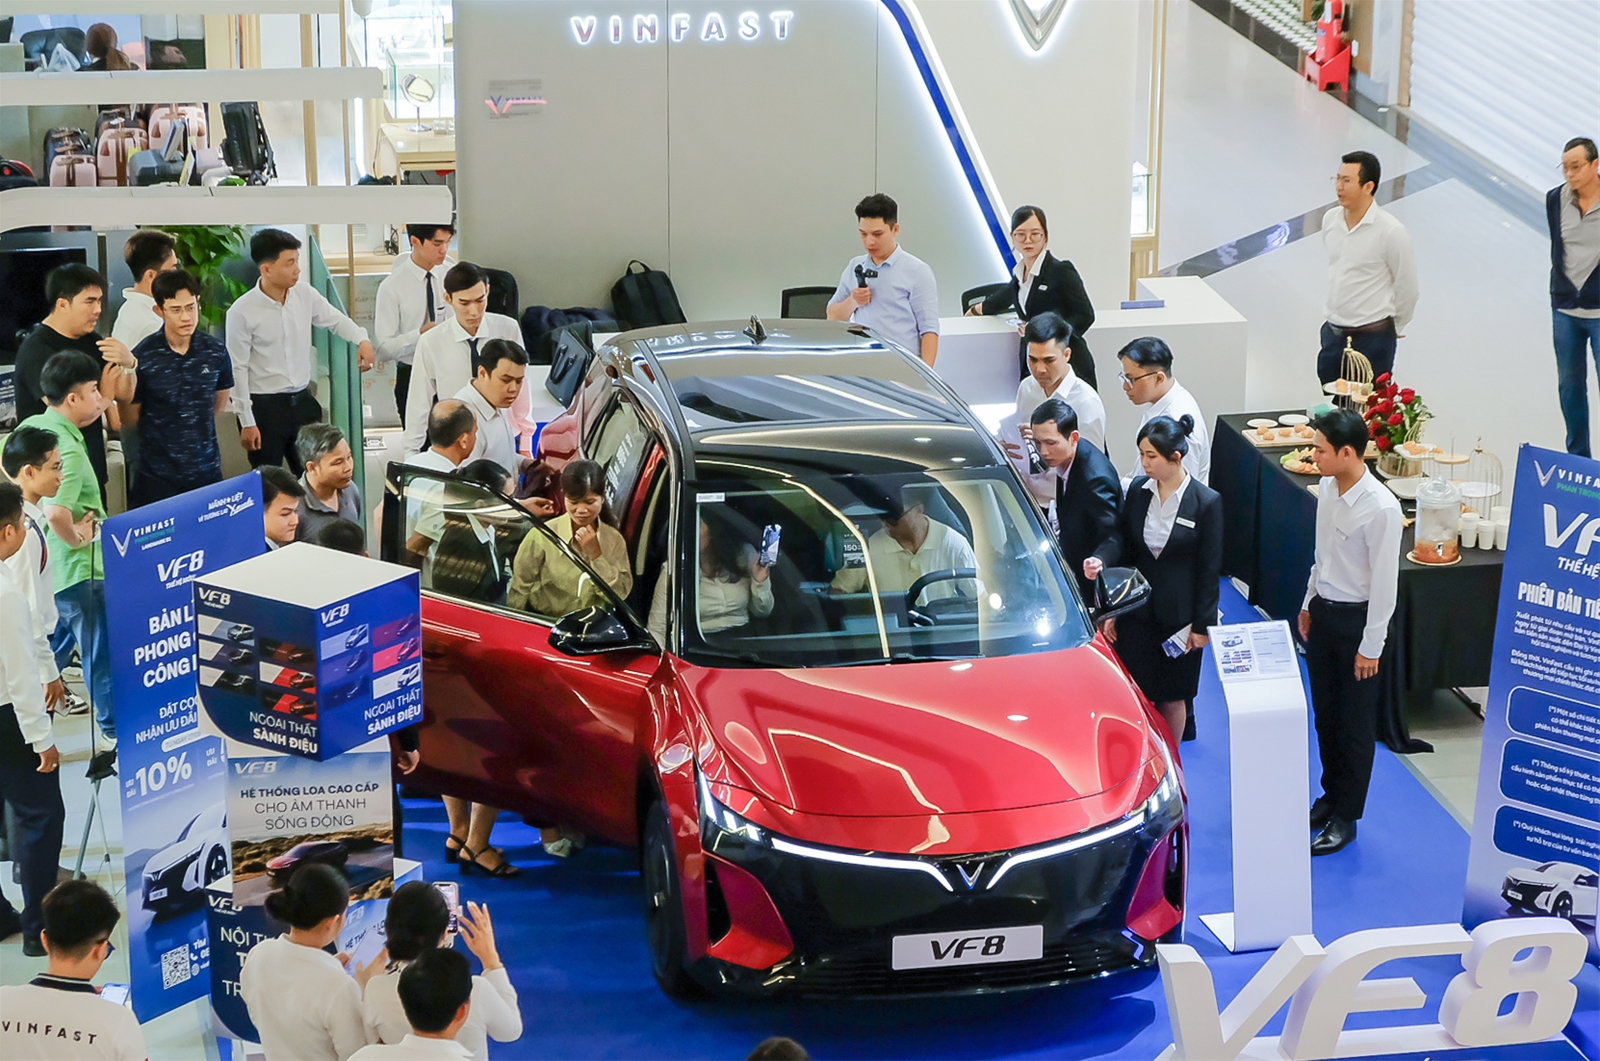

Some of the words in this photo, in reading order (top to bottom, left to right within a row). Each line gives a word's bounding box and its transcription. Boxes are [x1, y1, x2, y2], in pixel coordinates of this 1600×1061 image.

[571, 11, 794, 43] VINFAST
[133, 517, 175, 538] VINFAST
[843, 544, 858, 552] 150
[157, 550, 204, 582] VF8
[1557, 556, 1586, 573] THẾ
[1581, 563, 1600, 580] HỆ
[198, 587, 231, 606] VF8
[1517, 581, 1555, 608] PHIÊN
[1556, 588, 1582, 615] BẢN
[148, 607, 182, 635] BẢN
[321, 603, 350, 625] VF8
[133, 631, 191, 666] PHONG
[143, 657, 191, 688] CÔNG
[159, 701, 178, 719] ĐẶT
[364, 699, 395, 721] NGOẠI
[397, 687, 421, 706] THẤT
[135, 724, 165, 745] NHẬN
[164, 716, 179, 733] ƯU
[180, 711, 197, 727] ĐÃI
[249, 710, 286, 731] NGOẠI
[288, 720, 318, 738] THẤT
[367, 714, 396, 735] SÀNH
[397, 704, 422, 724] ĐIỆU
[252, 727, 287, 746] SÀNH
[289, 736, 319, 754] ĐIỆU
[135, 751, 192, 797] 10%
[234, 761, 277, 774] VF8
[240, 787, 256, 800] HỆ
[258, 784, 300, 798] THỐNG
[303, 786, 326, 796] LOA
[328, 784, 353, 794] CAO
[355, 780, 379, 793] CẤP
[254, 801, 287, 814] CHO
[290, 798, 313, 812] ÂM
[316, 798, 366, 810] THANH
[265, 814, 307, 830] SỐNG
[311, 813, 354, 829] ĐỘNG
[220, 925, 250, 947] NỘI
[930, 935, 1006, 960] VF8
[1155, 917, 1589, 1061] VF8
[2, 1021, 97, 1045] VINFAST
